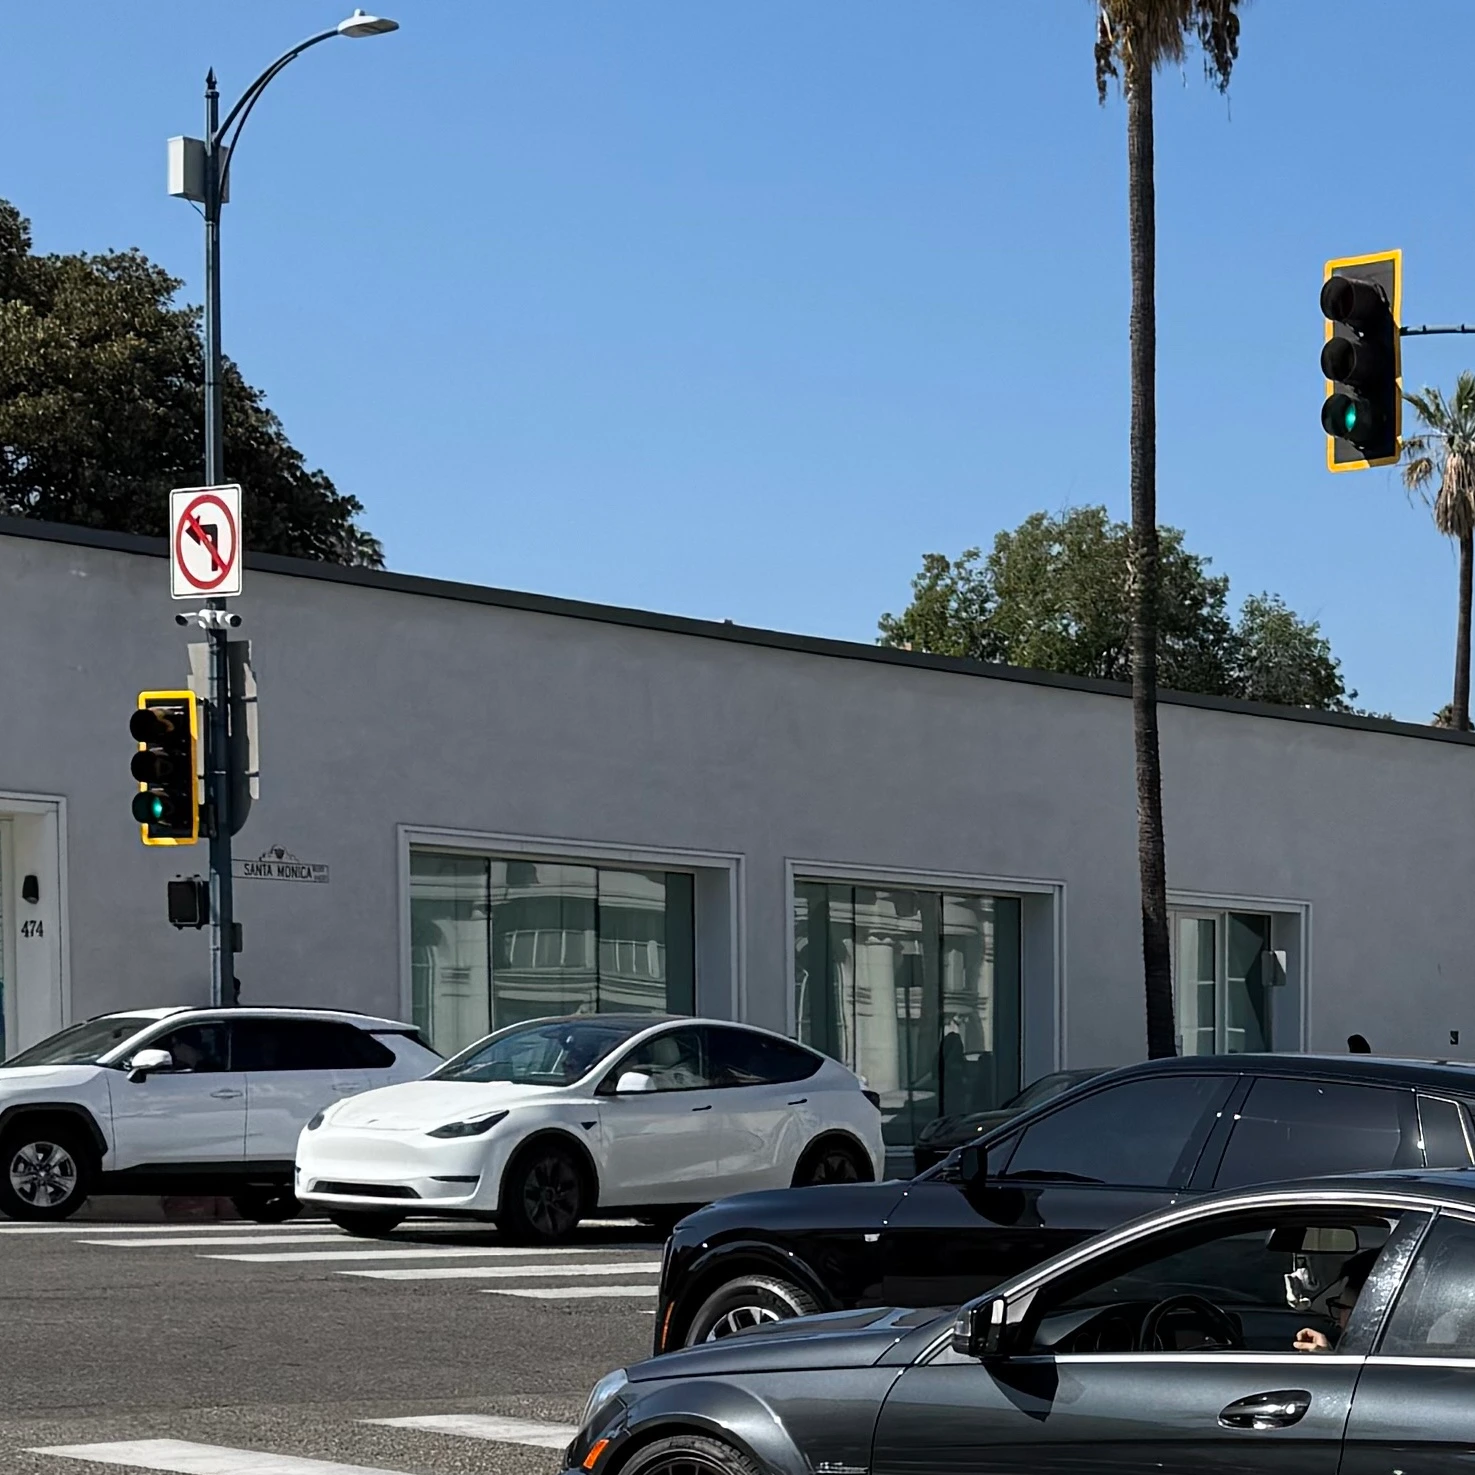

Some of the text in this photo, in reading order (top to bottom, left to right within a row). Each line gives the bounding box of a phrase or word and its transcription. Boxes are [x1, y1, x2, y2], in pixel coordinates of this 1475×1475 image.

[244, 863, 273, 877] SANTA
[277, 865, 313, 879] MONICA
[21, 919, 44, 938] 474
